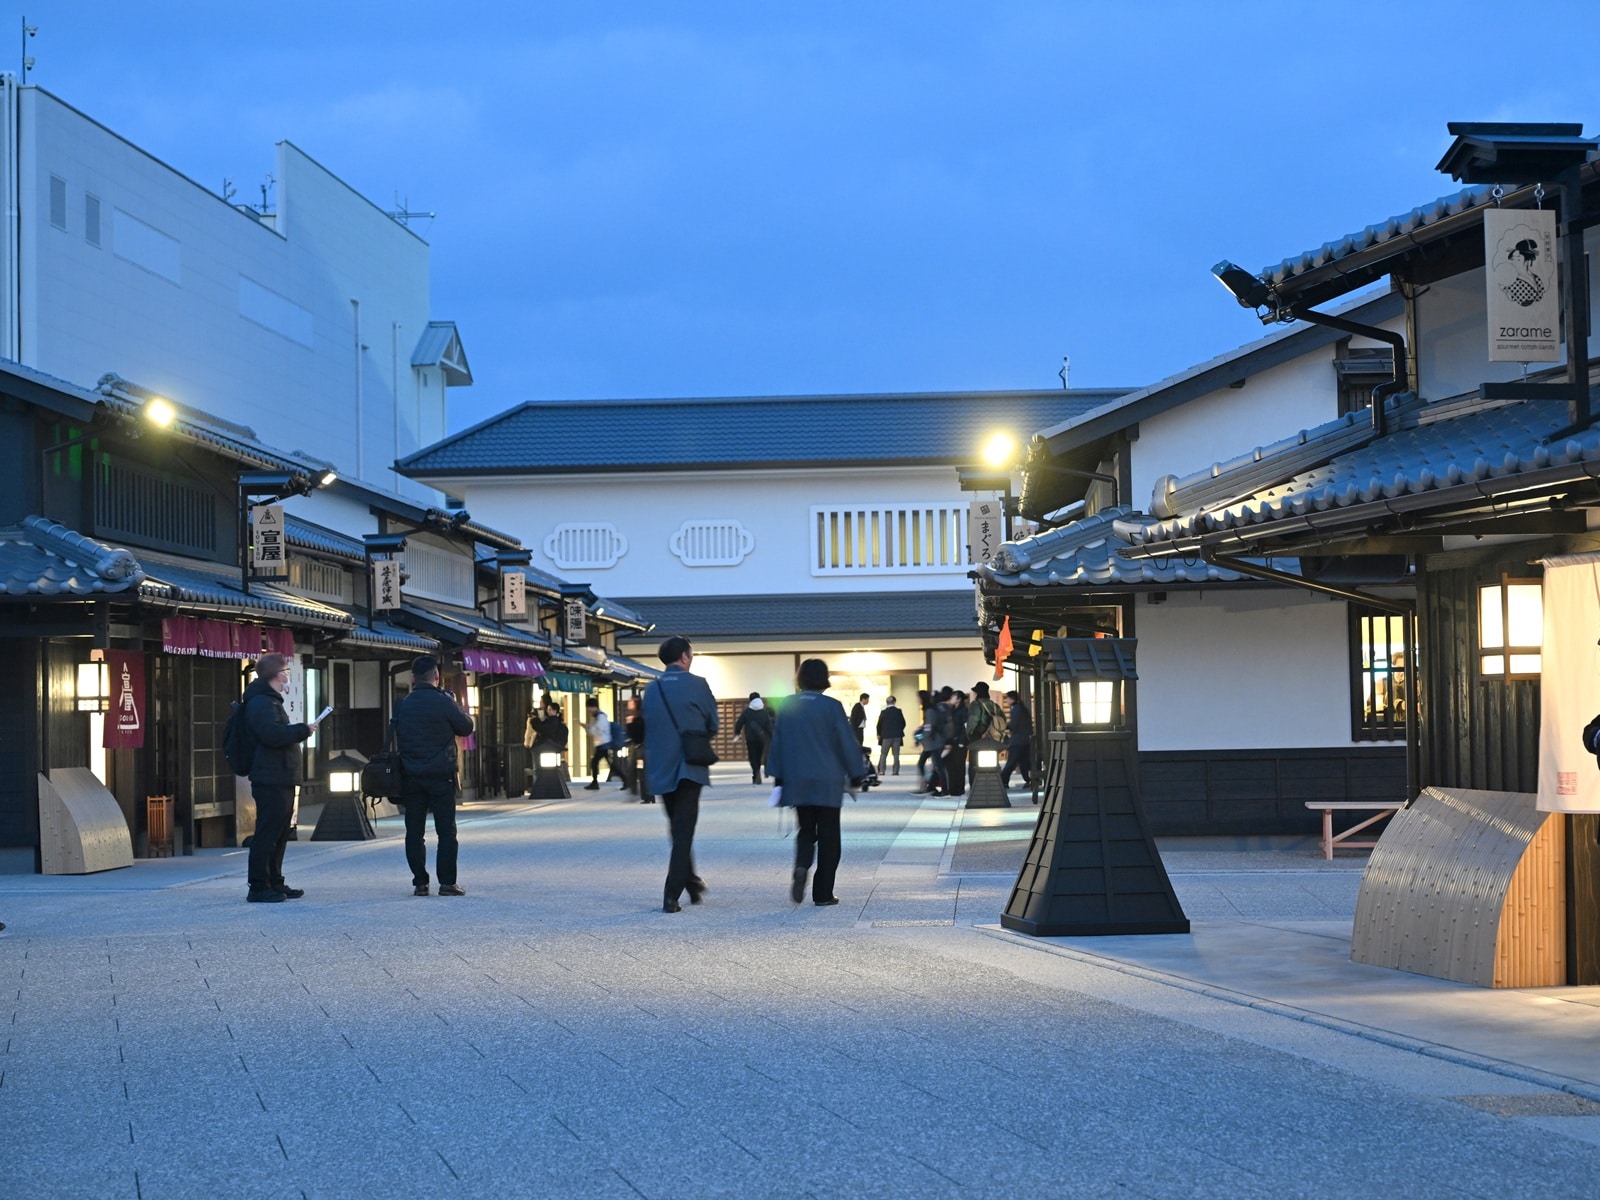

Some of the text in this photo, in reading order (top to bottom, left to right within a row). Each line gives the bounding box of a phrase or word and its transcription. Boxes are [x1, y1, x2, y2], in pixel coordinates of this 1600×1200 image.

[1499, 327, 1552, 338] zarame
[981, 520, 992, 560] まぐろ
